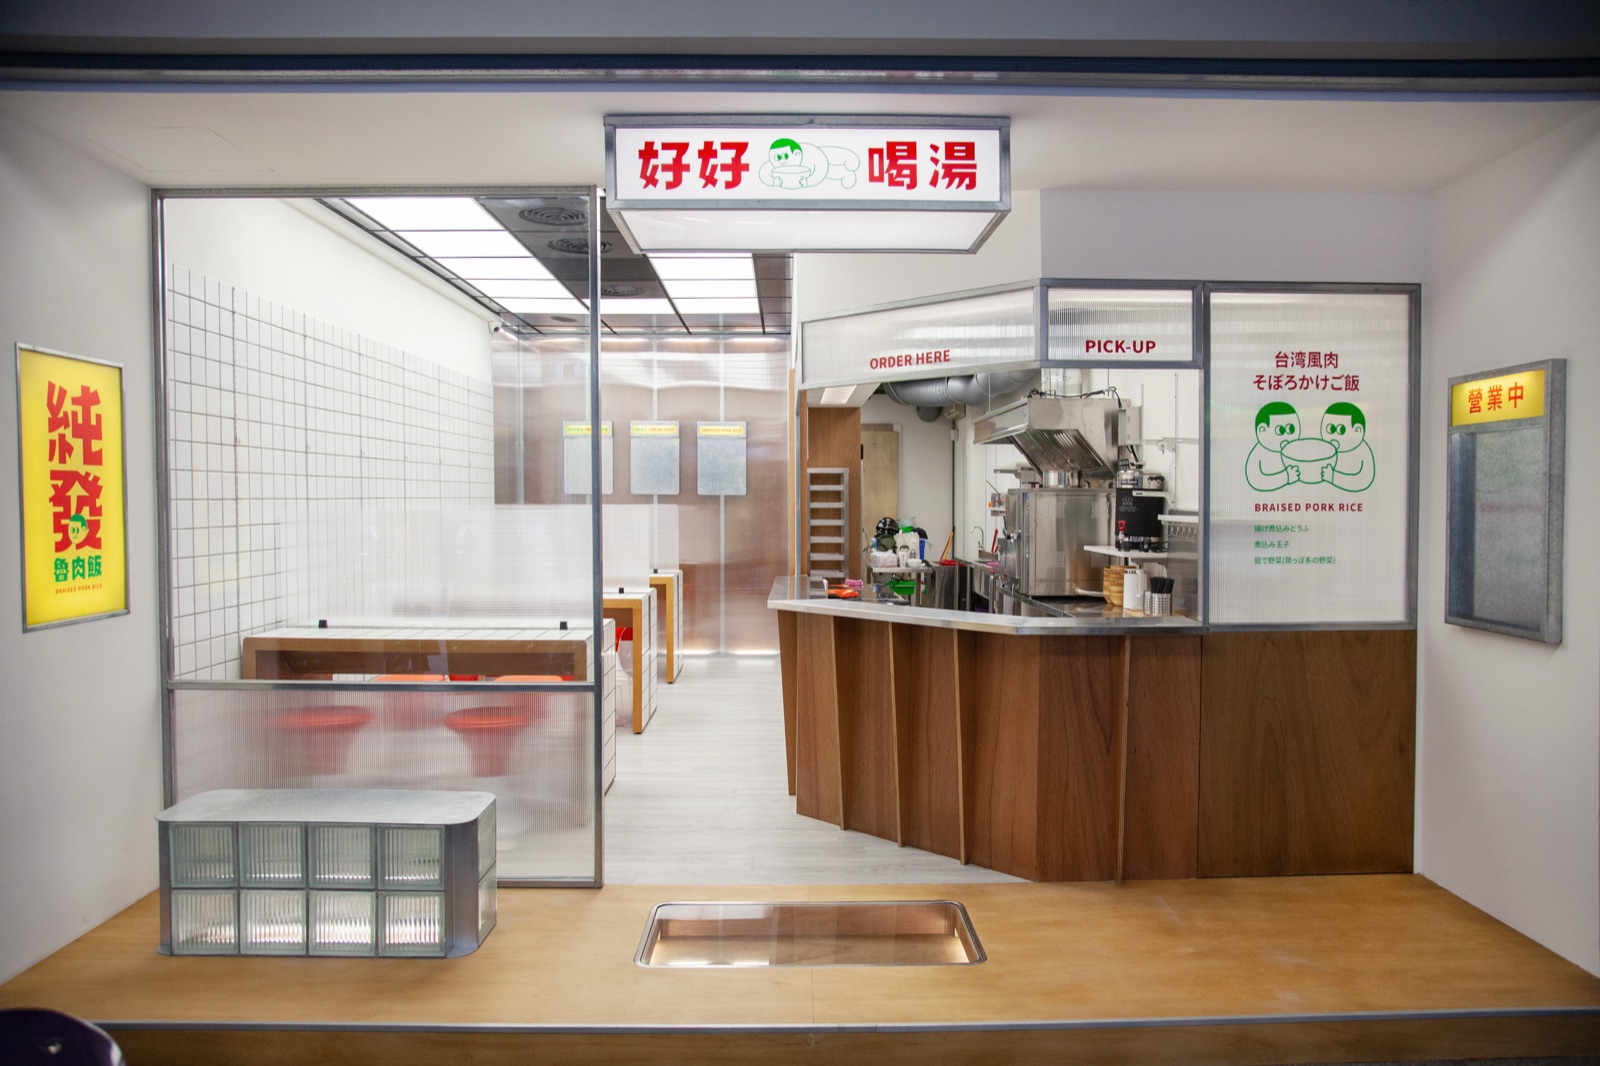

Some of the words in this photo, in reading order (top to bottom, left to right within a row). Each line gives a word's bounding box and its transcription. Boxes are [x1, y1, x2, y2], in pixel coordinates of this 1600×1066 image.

[638, 141, 750, 190] 好好
[868, 141, 978, 190] 喝湯
[1085, 339, 1156, 353] PICK-UP
[869, 354, 913, 370] ORDER
[916, 349, 951, 365] HERE
[1275, 351, 1338, 369] 台湾風肉
[1253, 374, 1360, 391] そぼろかけご飯
[1468, 381, 1524, 414] 營業中
[1254, 502, 1302, 512] BRAISED
[1305, 502, 1335, 512] PORK
[1338, 502, 1363, 512] RICE
[54, 555, 102, 582] 魯肉飯
